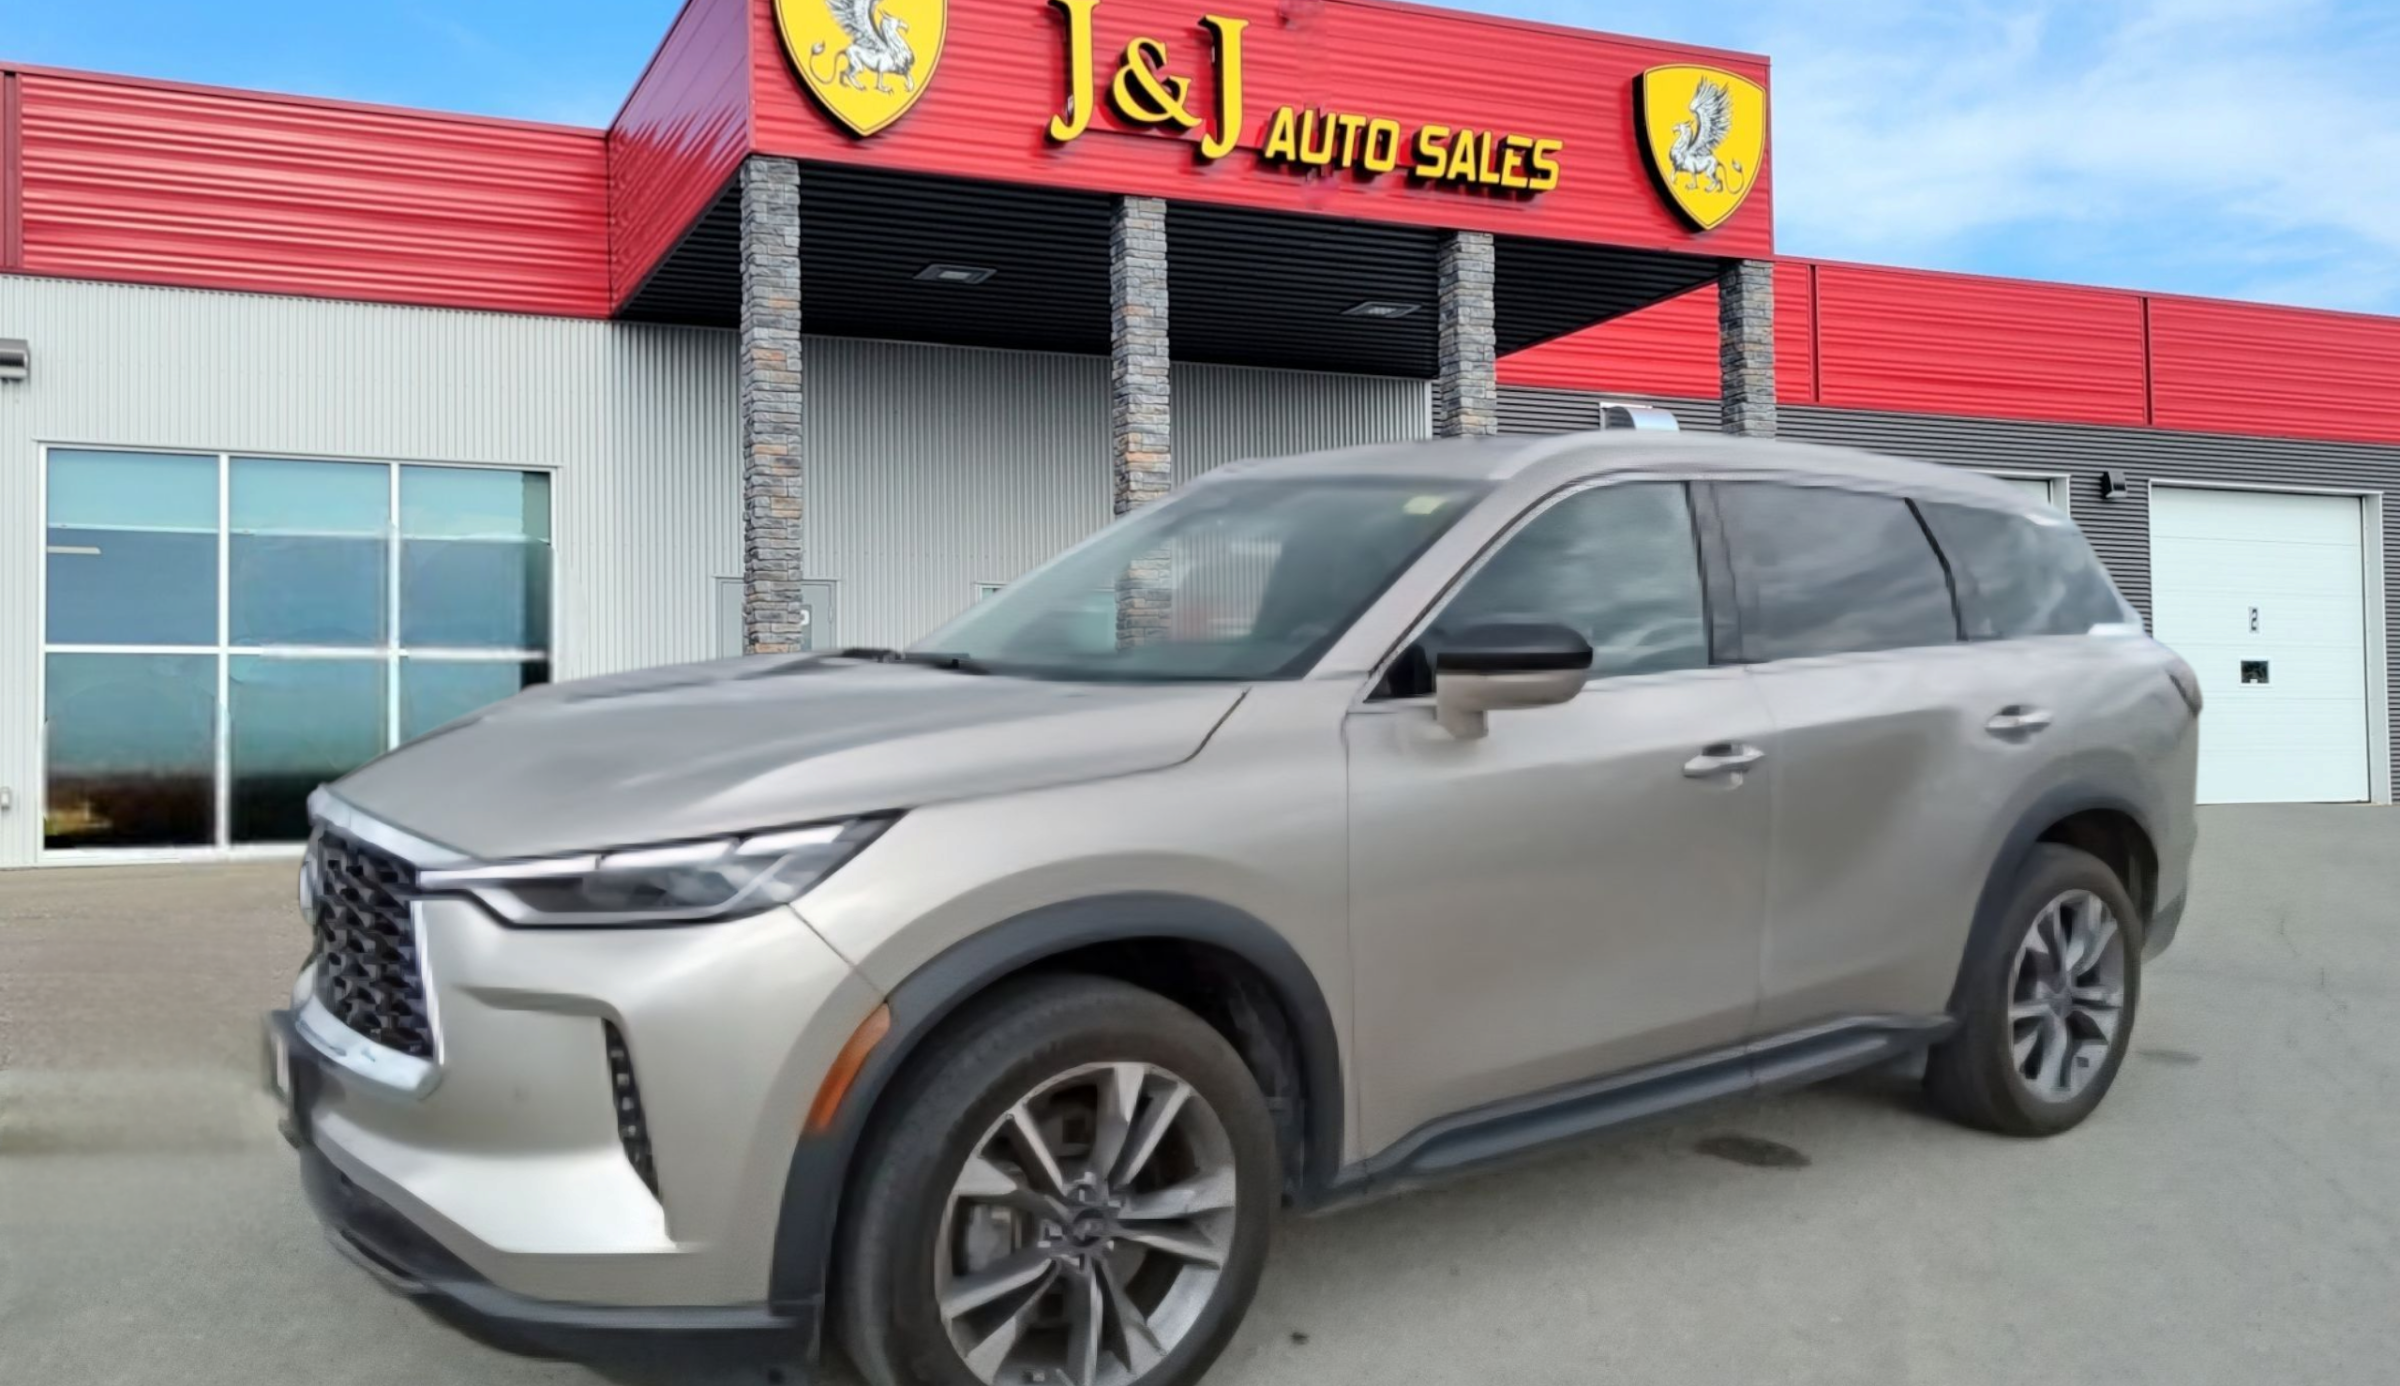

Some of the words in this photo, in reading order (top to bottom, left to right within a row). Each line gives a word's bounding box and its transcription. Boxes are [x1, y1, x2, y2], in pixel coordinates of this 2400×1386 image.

[1049, 0, 1248, 159] J&J
[1264, 106, 1401, 172] AUTO
[1415, 125, 1564, 191] SALES
